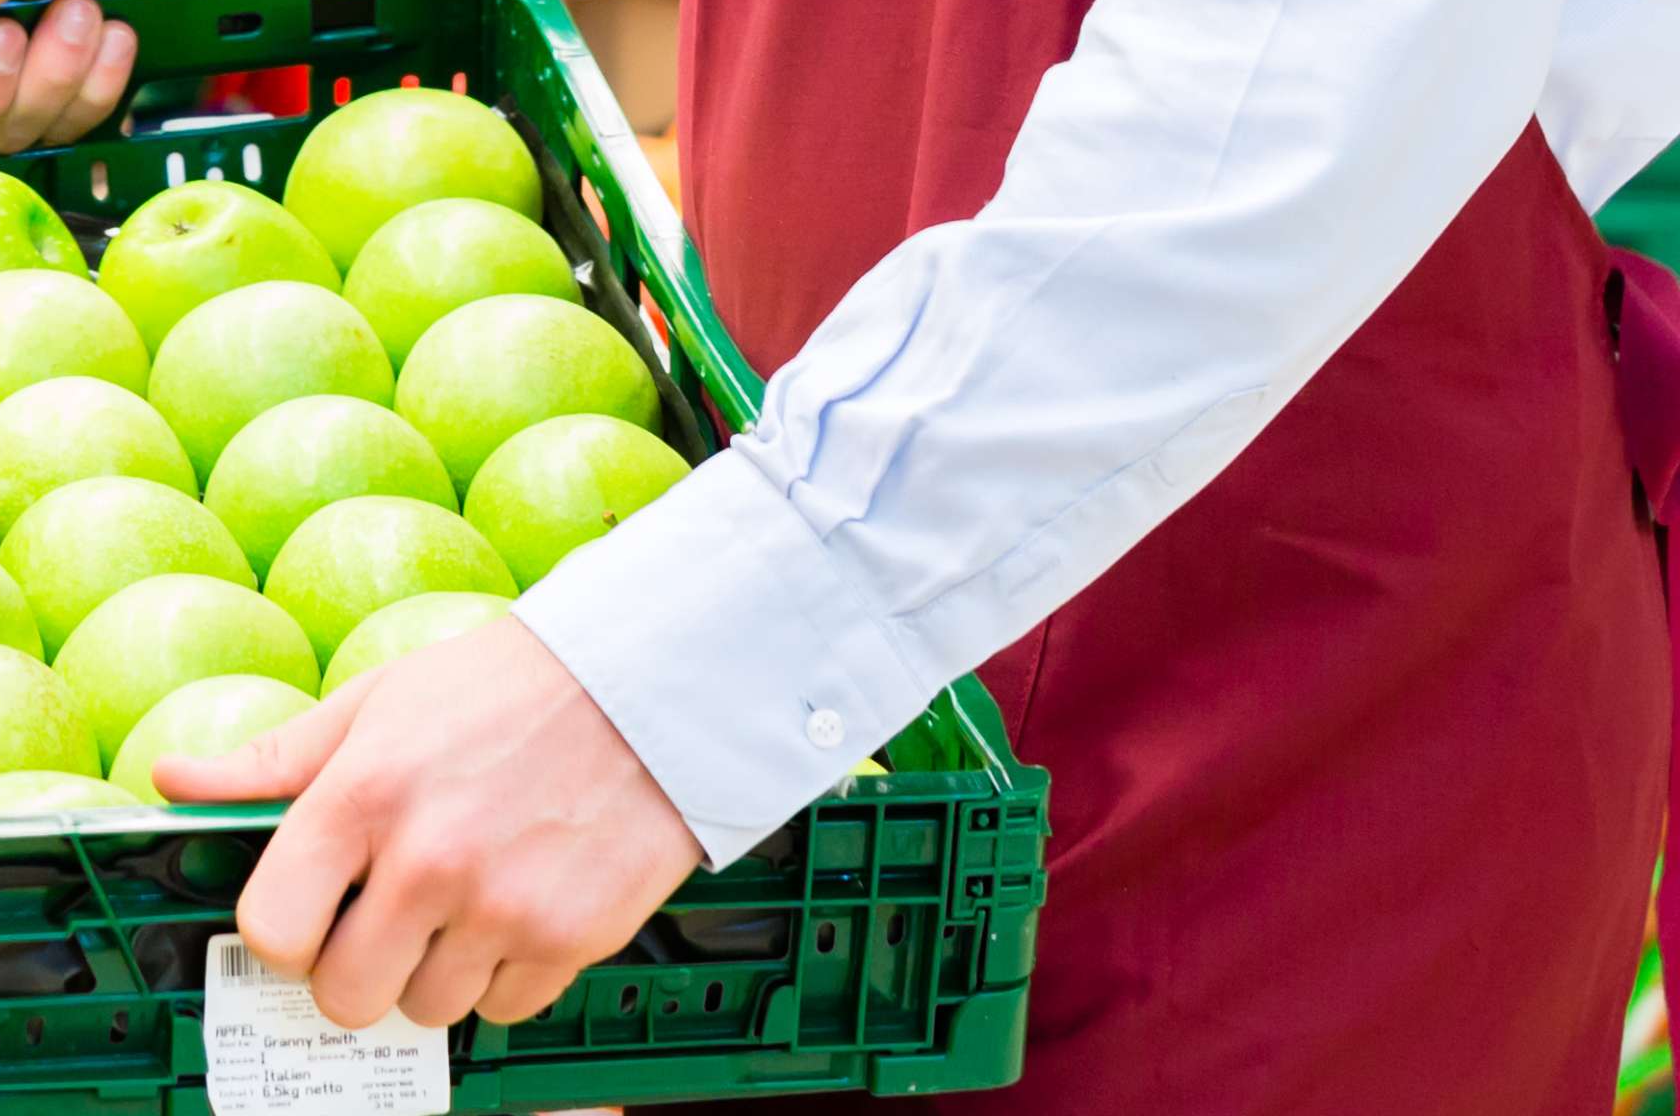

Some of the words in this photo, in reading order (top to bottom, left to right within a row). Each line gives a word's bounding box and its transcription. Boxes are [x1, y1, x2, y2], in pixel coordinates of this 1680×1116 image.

[215, 1024, 257, 1038] APFEL
[263, 1034, 313, 1050] Granny
[319, 1031, 358, 1046] Smith
[349, 1046, 392, 1061] 75-80
[396, 1046, 420, 1058] mm
[263, 1068, 312, 1083] Italien
[304, 1083, 343, 1096] netto
